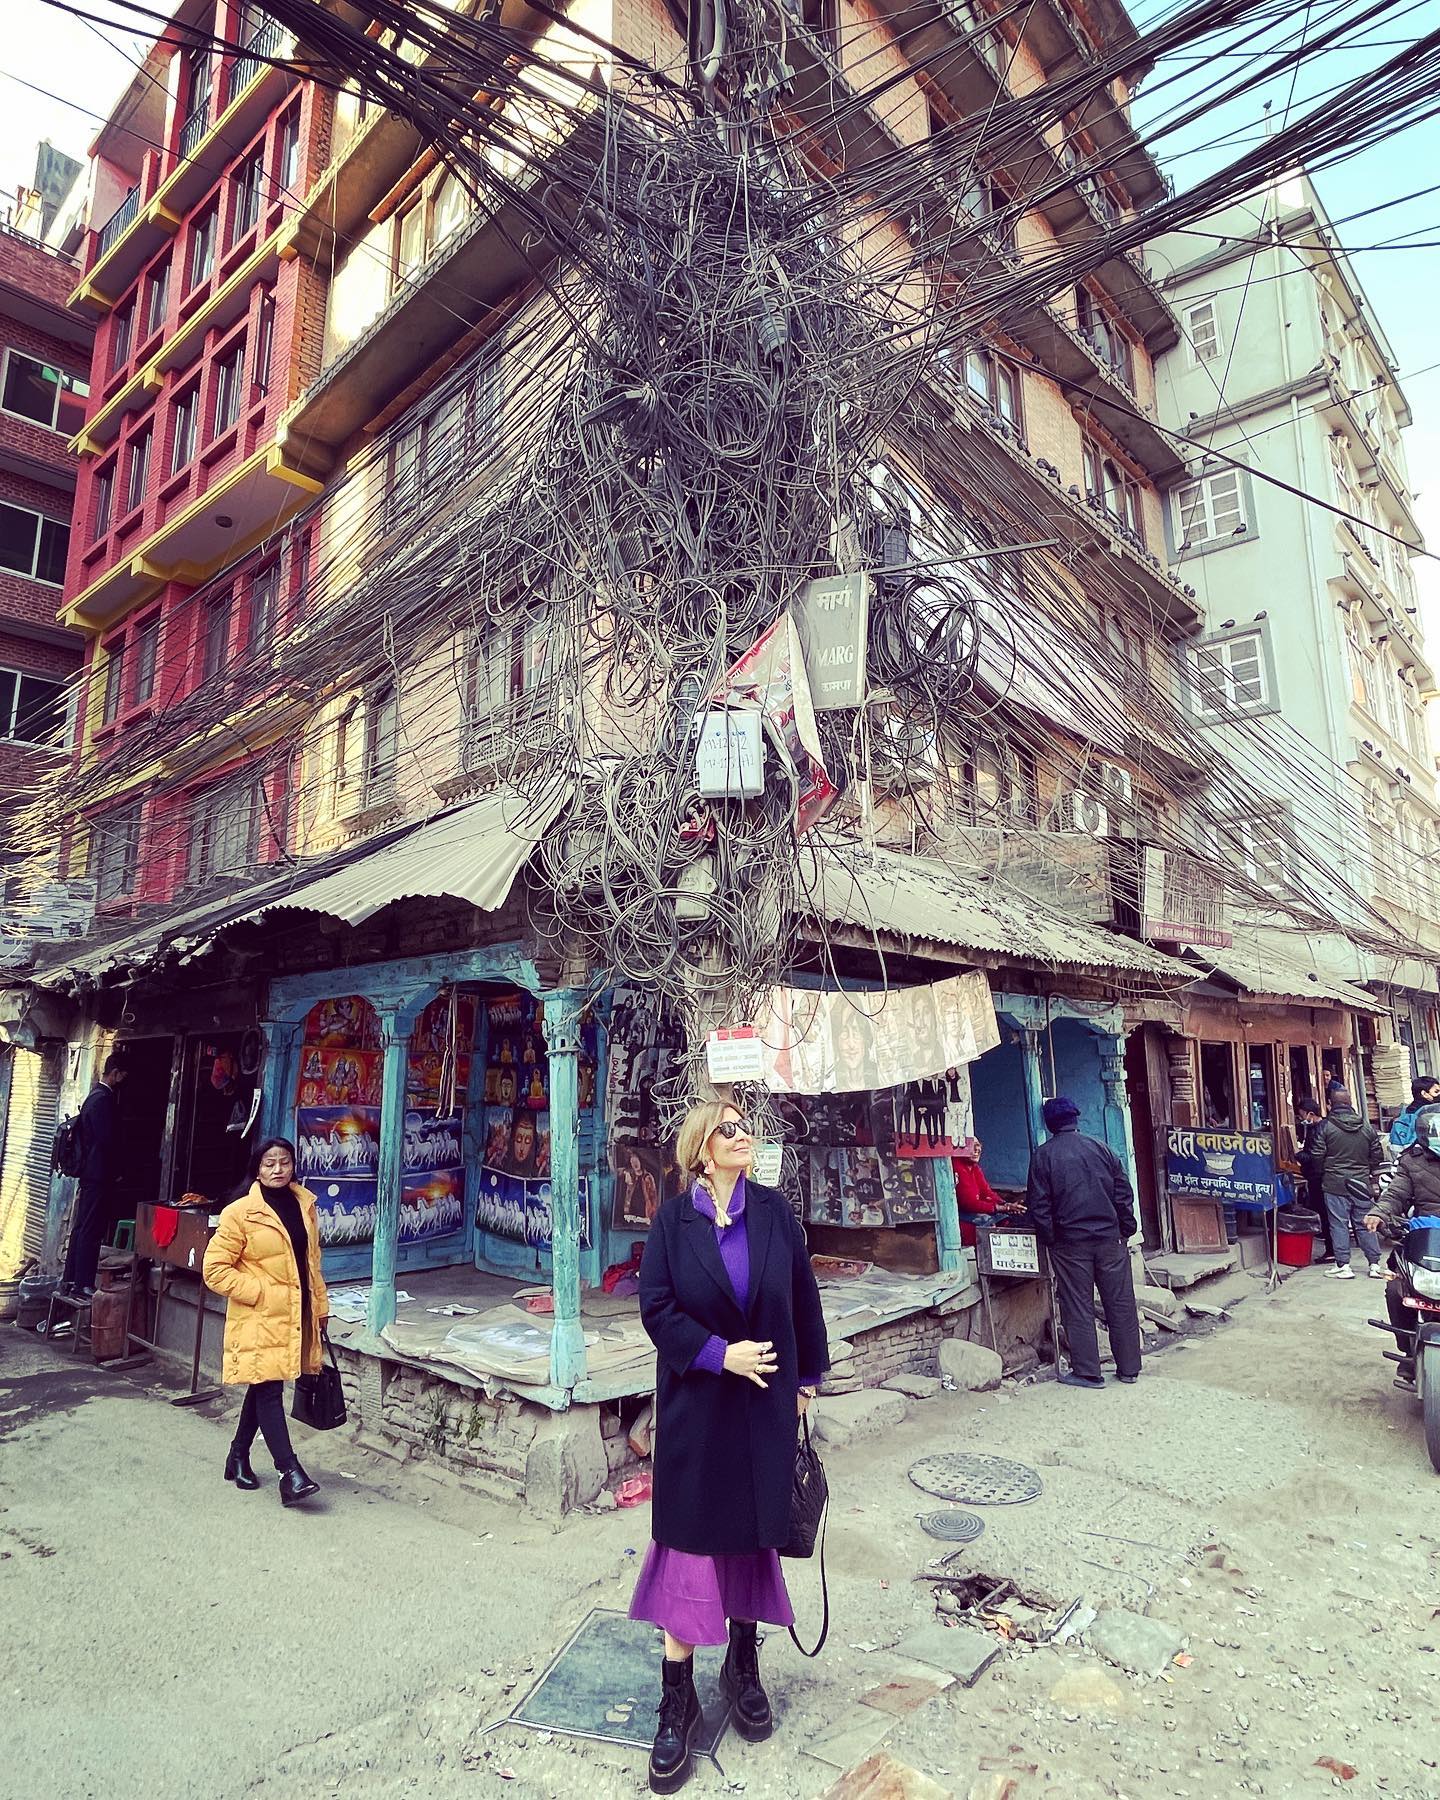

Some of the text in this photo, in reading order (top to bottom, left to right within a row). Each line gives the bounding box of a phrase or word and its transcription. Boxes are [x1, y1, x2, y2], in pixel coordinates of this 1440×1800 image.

[816, 584, 853, 611] मार्ग
[815, 644, 854, 667] MARG
[1168, 1127, 1200, 1161] दाँत
[1196, 1131, 1246, 1155] बनाउने
